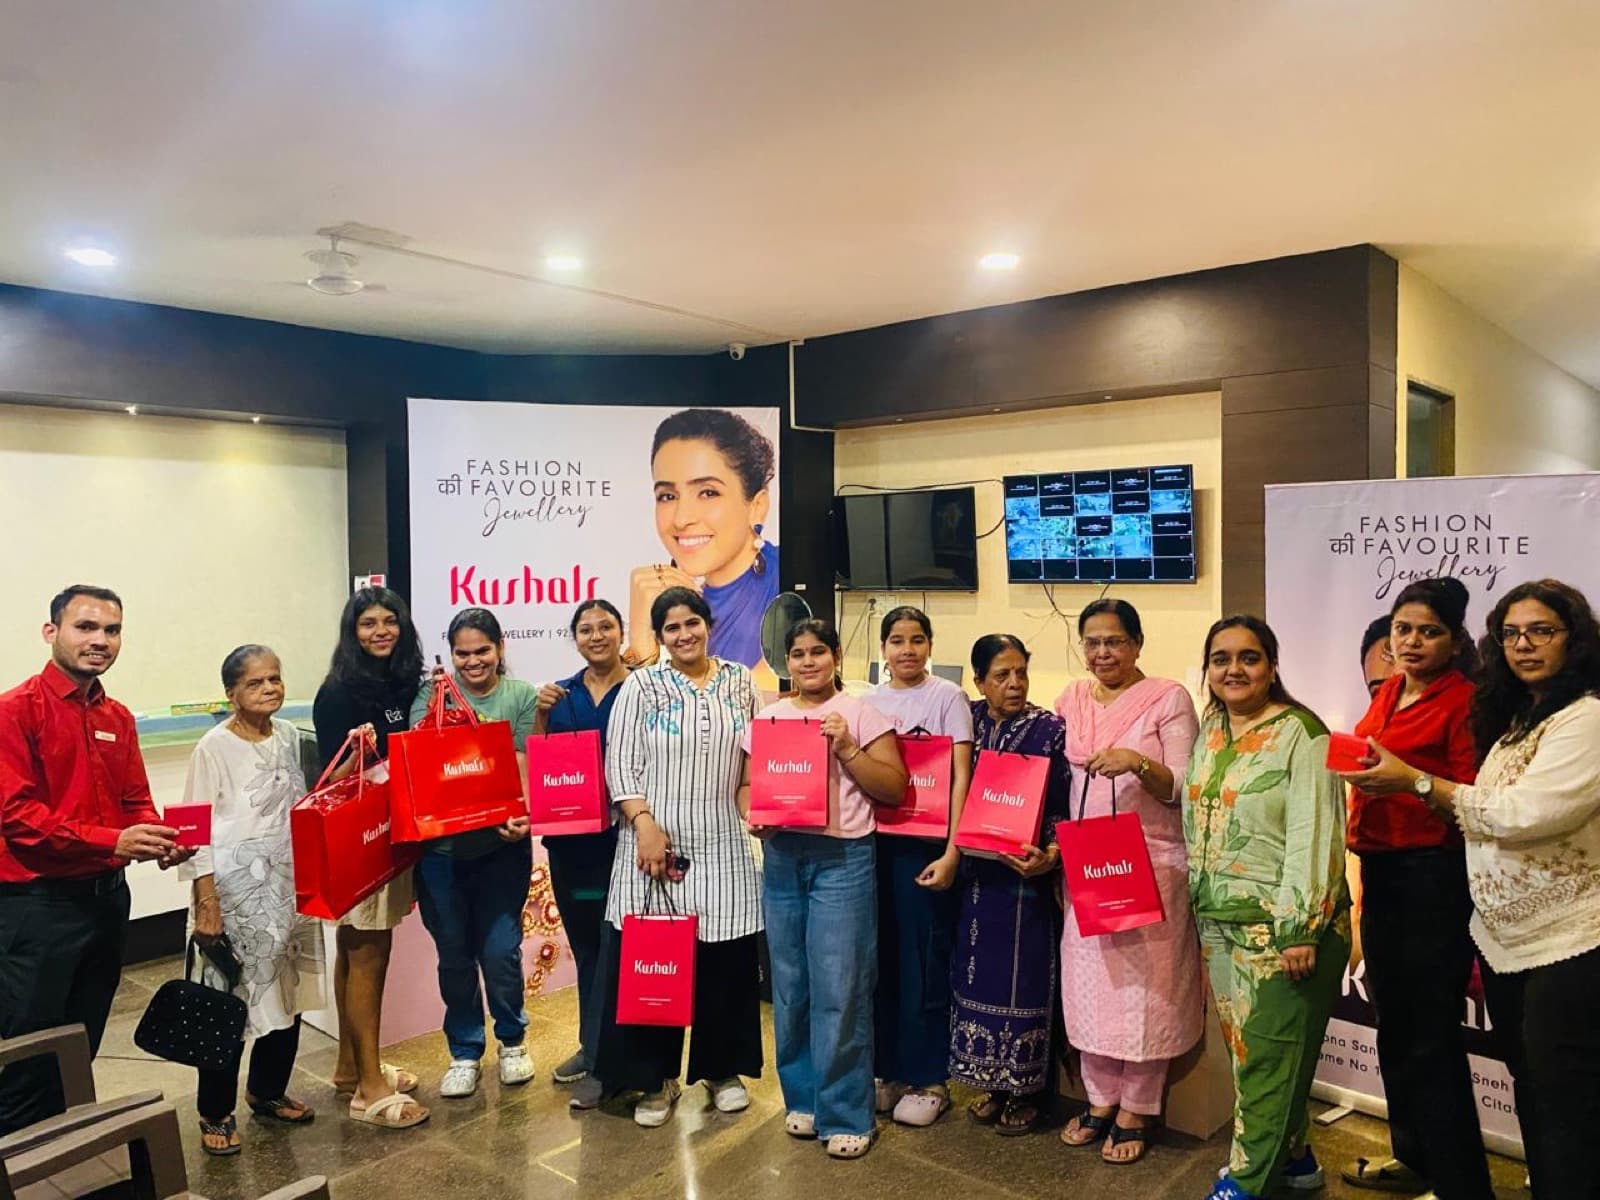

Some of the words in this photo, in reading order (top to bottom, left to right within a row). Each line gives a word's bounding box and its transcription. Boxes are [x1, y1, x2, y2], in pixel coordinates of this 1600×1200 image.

[467, 459, 582, 476] FASHION
[436, 473, 463, 496] की
[471, 479, 612, 497] FAVOURITE
[482, 496, 593, 537] Jewellery
[1360, 514, 1492, 533] FASHION
[1328, 532, 1356, 556] की
[1364, 536, 1529, 555] FAVOURITE
[1375, 554, 1506, 600] Jewellery
[500, 628, 545, 640] WELLERY
[556, 628, 570, 638] 92
[443, 758, 484, 777] Kushals
[767, 758, 812, 774] Kushals
[543, 770, 585, 788] Kushals
[908, 773, 937, 788] shals
[982, 787, 1026, 808] Kushals
[1083, 859, 1134, 880] Kushals
[634, 959, 678, 975] Kushals
[1323, 1034, 1346, 1048] ona
[1351, 1039, 1377, 1057] San
[1472, 1072, 1509, 1092] Sneh
[1349, 1057, 1368, 1072] No
[1481, 1095, 1515, 1114] Cita
